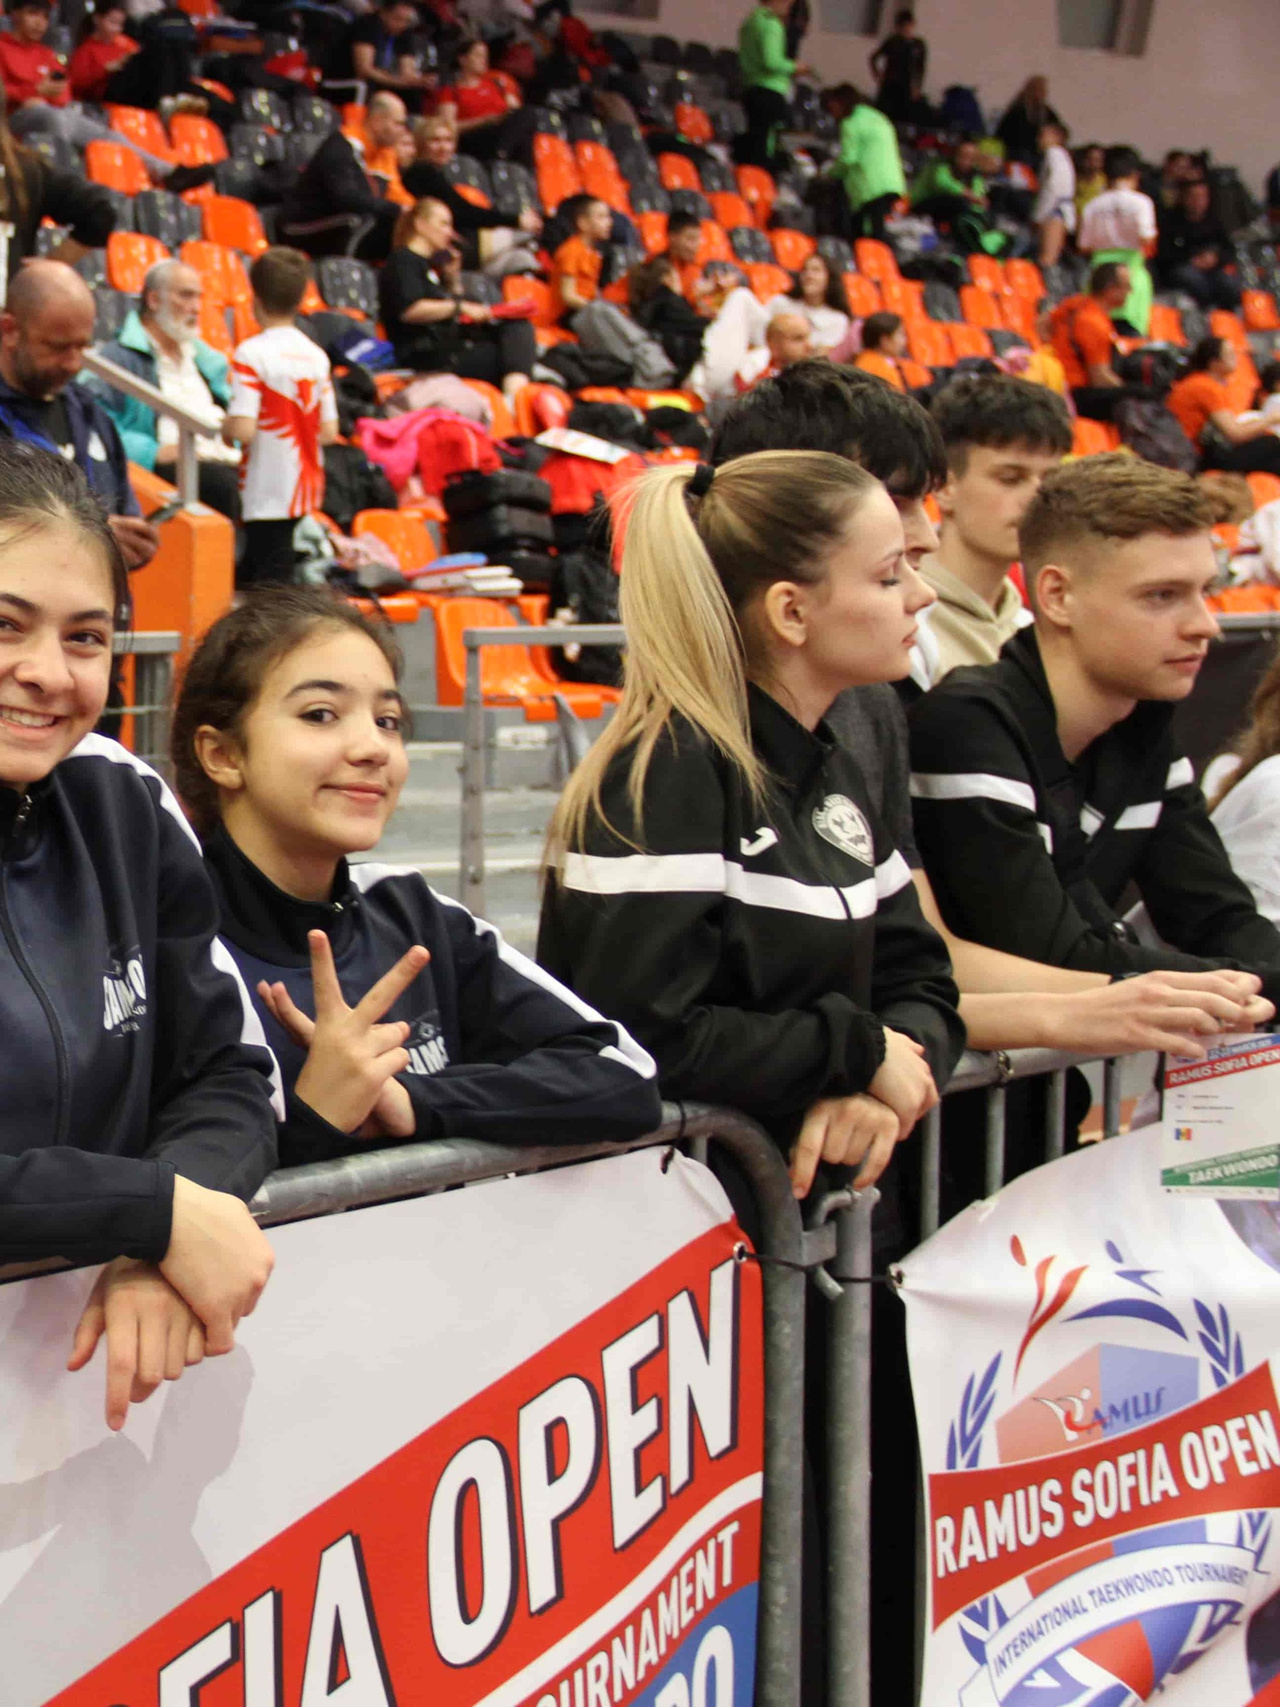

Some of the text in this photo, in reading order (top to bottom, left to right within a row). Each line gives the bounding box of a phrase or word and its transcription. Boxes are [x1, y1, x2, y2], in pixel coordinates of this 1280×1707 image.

[1168, 1064, 1213, 1085] RAMUS
[427, 1256, 741, 1669] OPEN
[935, 1409, 1280, 1578] RAMUS SOFIA OPEN
[993, 1595, 1089, 1677] INTERNATIONAL
[1088, 1571, 1175, 1610] TAEKWONDO
